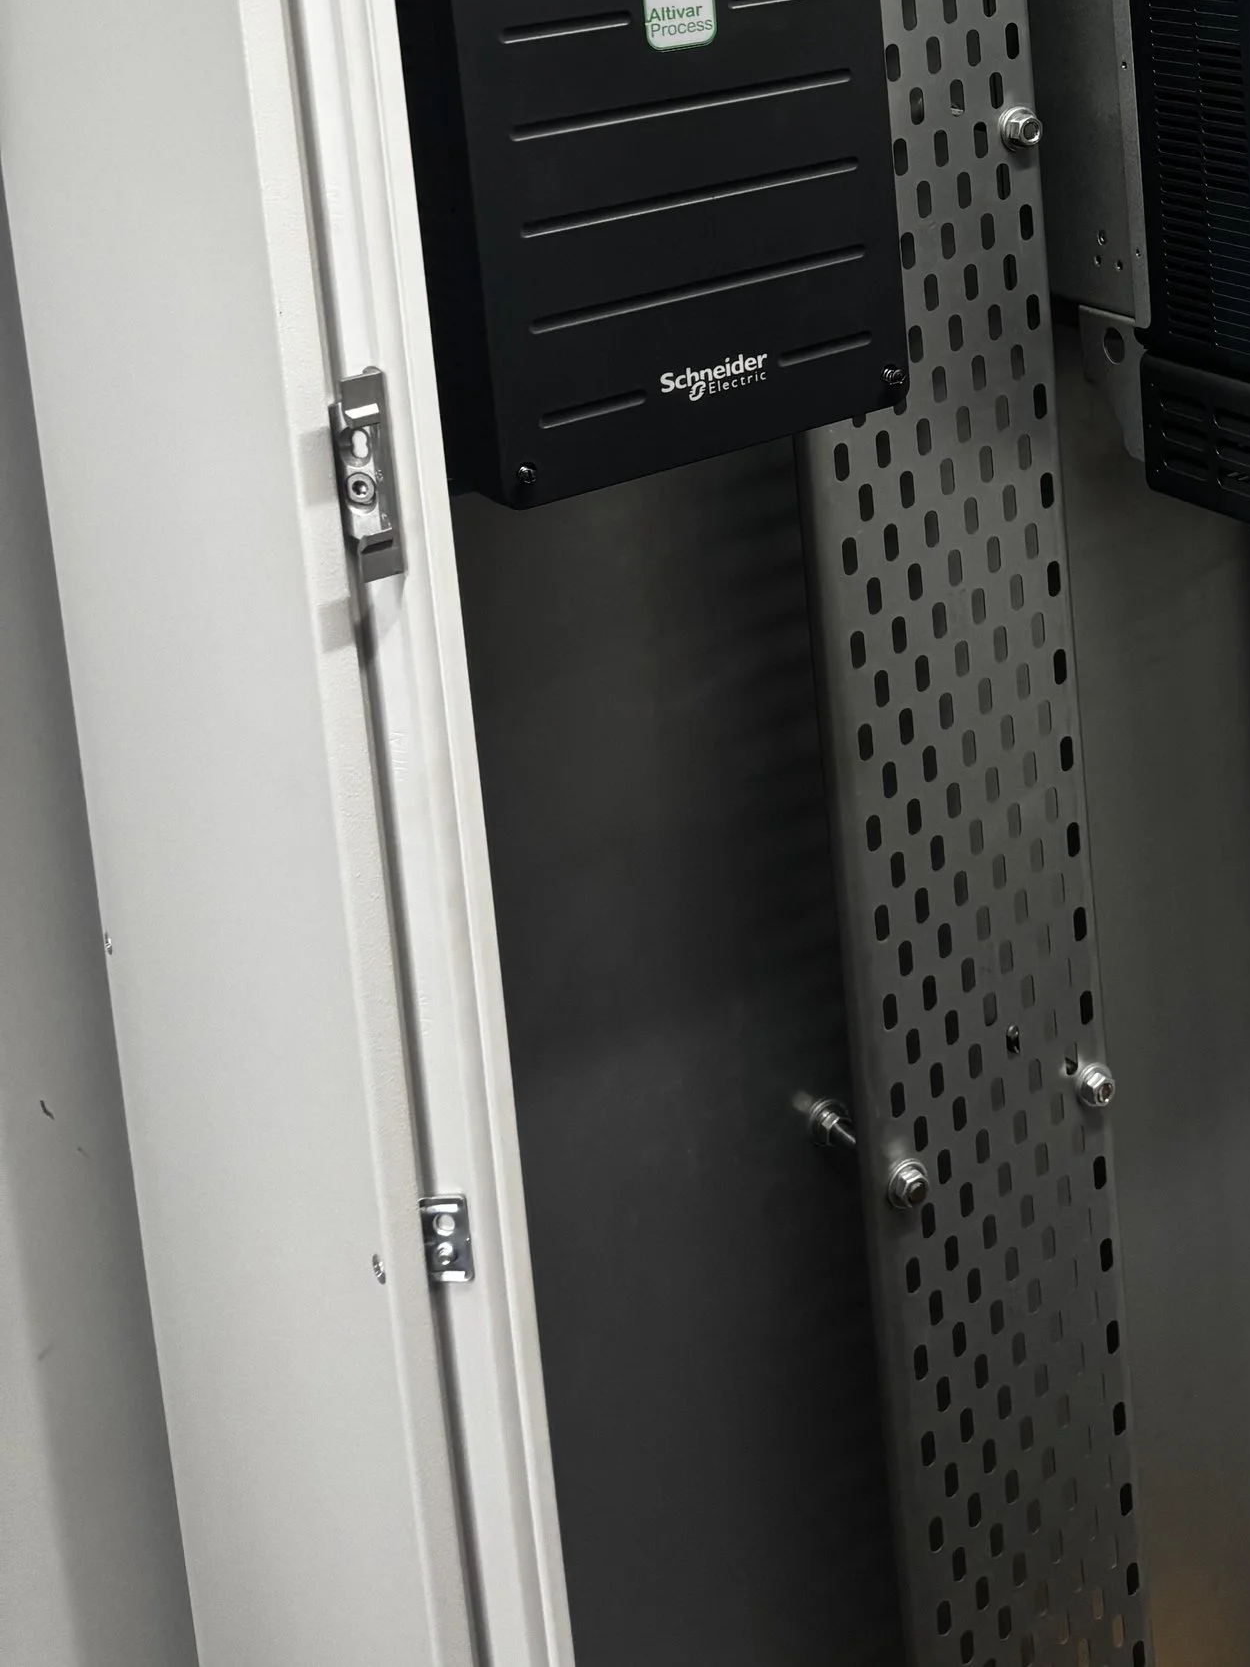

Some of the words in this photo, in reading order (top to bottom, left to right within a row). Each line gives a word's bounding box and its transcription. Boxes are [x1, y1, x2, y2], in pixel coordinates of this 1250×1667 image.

[648, 5, 703, 23] Altivar
[650, 19, 713, 38] Process
[660, 353, 768, 393] Schneider
[708, 371, 767, 395] Electric
